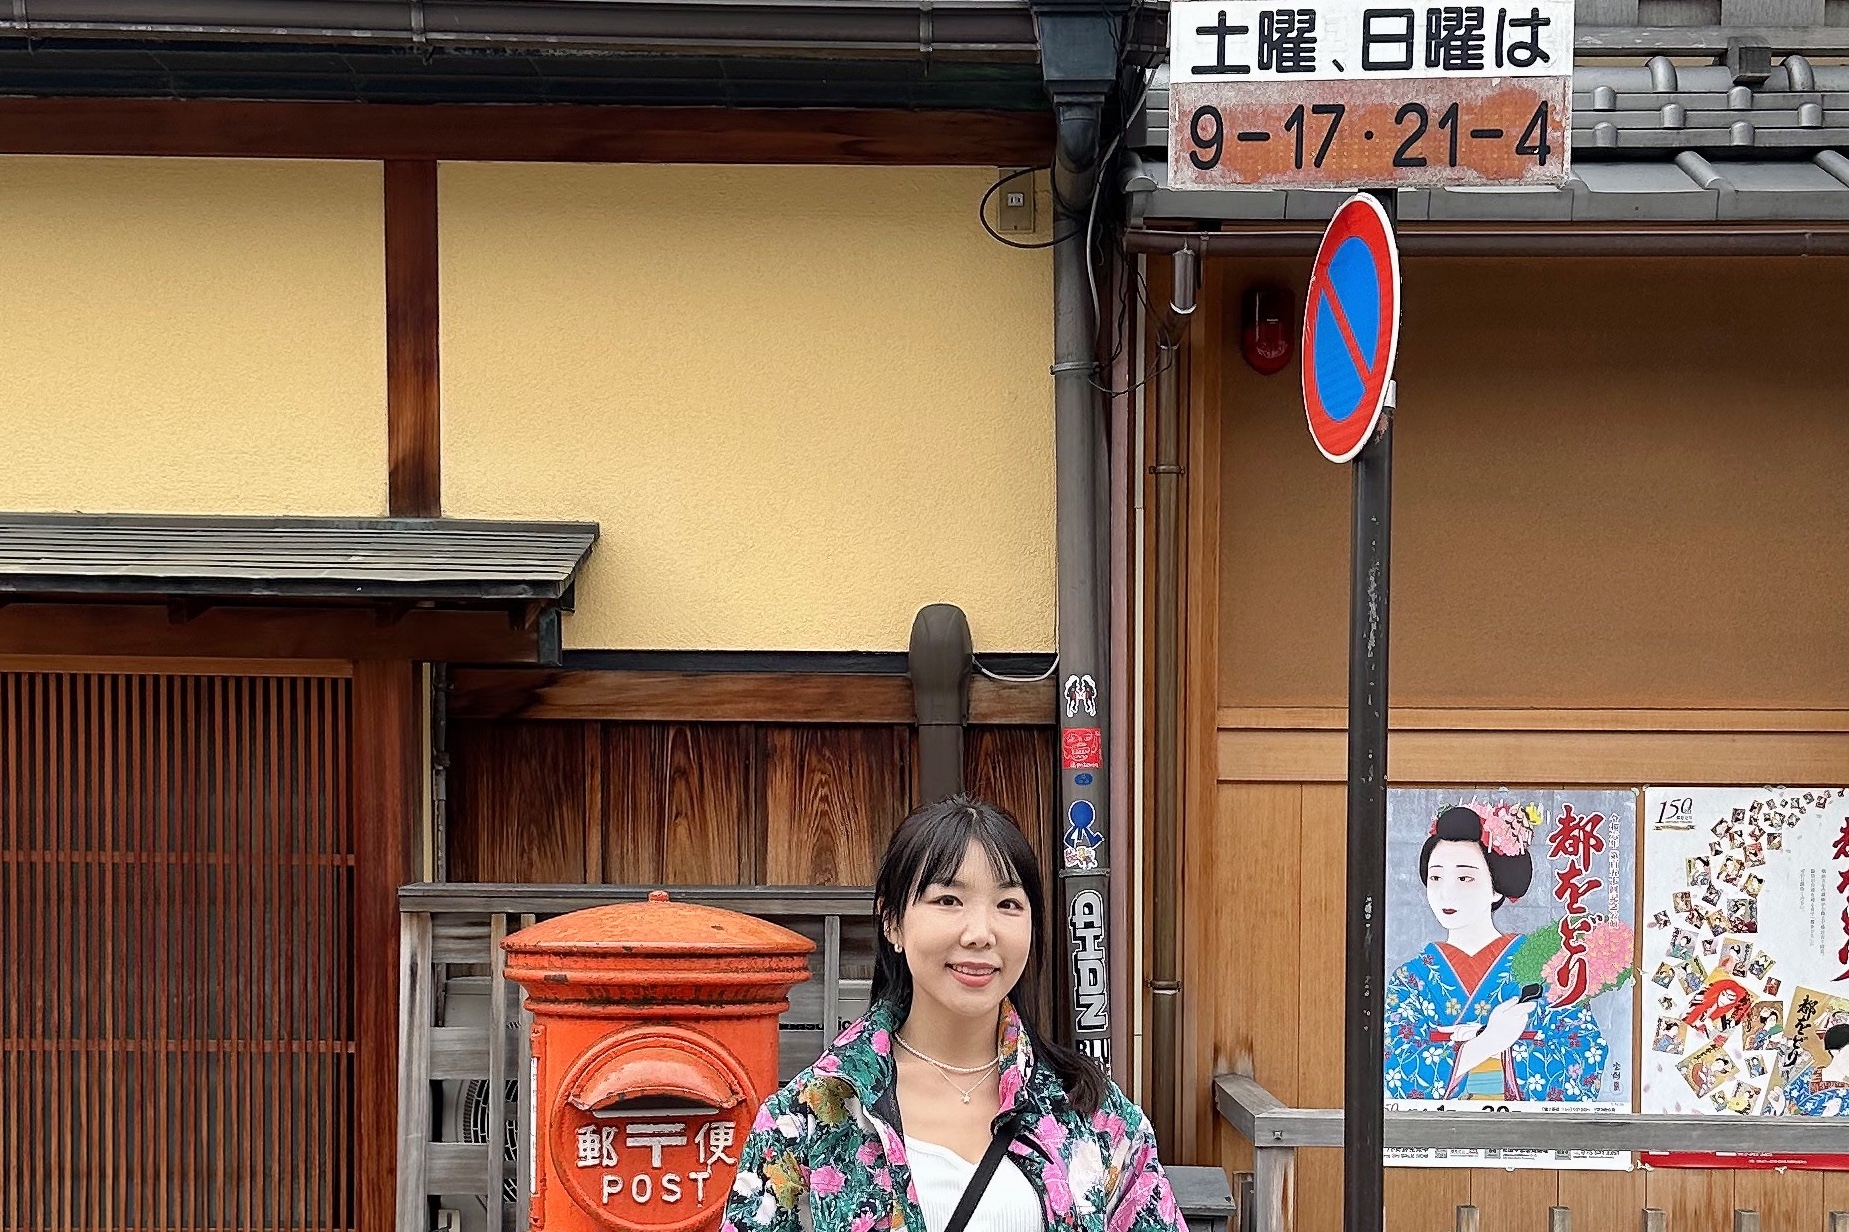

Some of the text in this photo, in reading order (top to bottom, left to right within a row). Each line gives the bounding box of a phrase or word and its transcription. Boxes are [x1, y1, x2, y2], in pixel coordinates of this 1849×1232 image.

[1191, 6, 1551, 75] 土曜、日曜は
[1655, 797, 1693, 824] 150
[1548, 804, 1605, 1009] 都をどり
[602, 1172, 710, 1205] POST
